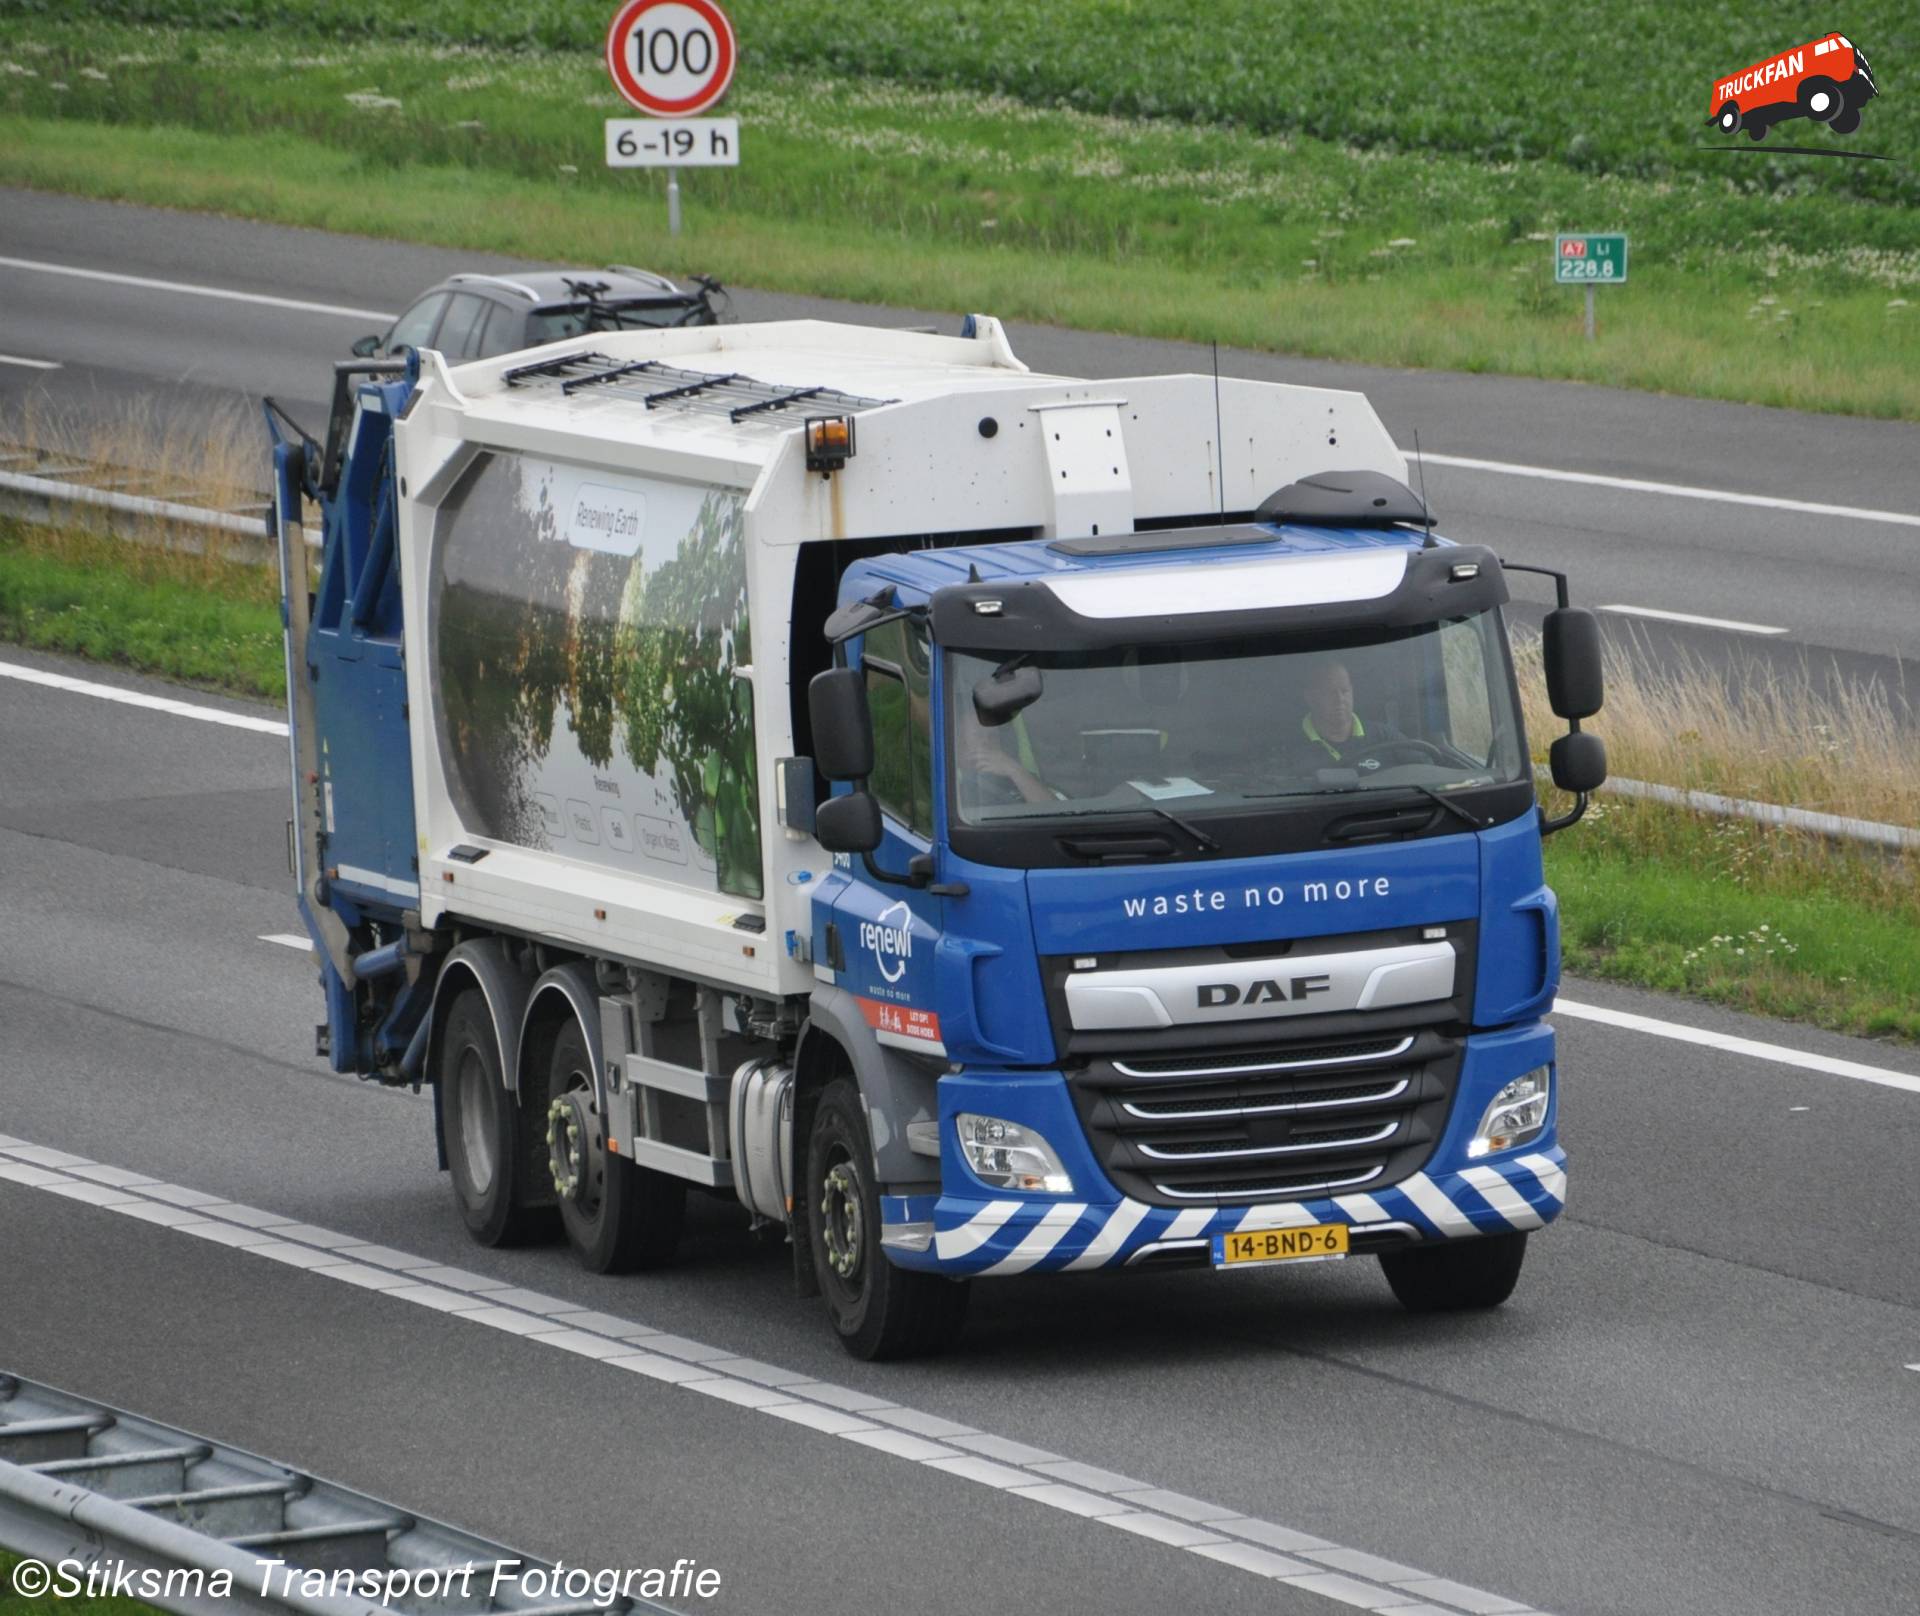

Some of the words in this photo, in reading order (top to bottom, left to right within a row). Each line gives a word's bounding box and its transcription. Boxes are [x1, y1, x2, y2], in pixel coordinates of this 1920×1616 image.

[632, 28, 712, 75] 100
[616, 128, 694, 157] 6-19
[711, 128, 728, 156] h
[1564, 242, 1584, 256] A7
[1561, 260, 1613, 277] 228.8
[575, 501, 614, 538] Renewing
[614, 507, 638, 537] Earth
[1124, 889, 1225, 918] waste
[1245, 886, 1284, 908] no
[1304, 877, 1390, 902] more
[860, 921, 913, 958] renewi
[869, 985, 885, 997] waste
[886, 989, 894, 999] no
[895, 991, 911, 1002] more
[1197, 974, 1330, 1008] DAF
[1232, 1229, 1338, 1258] 14-BND-6
